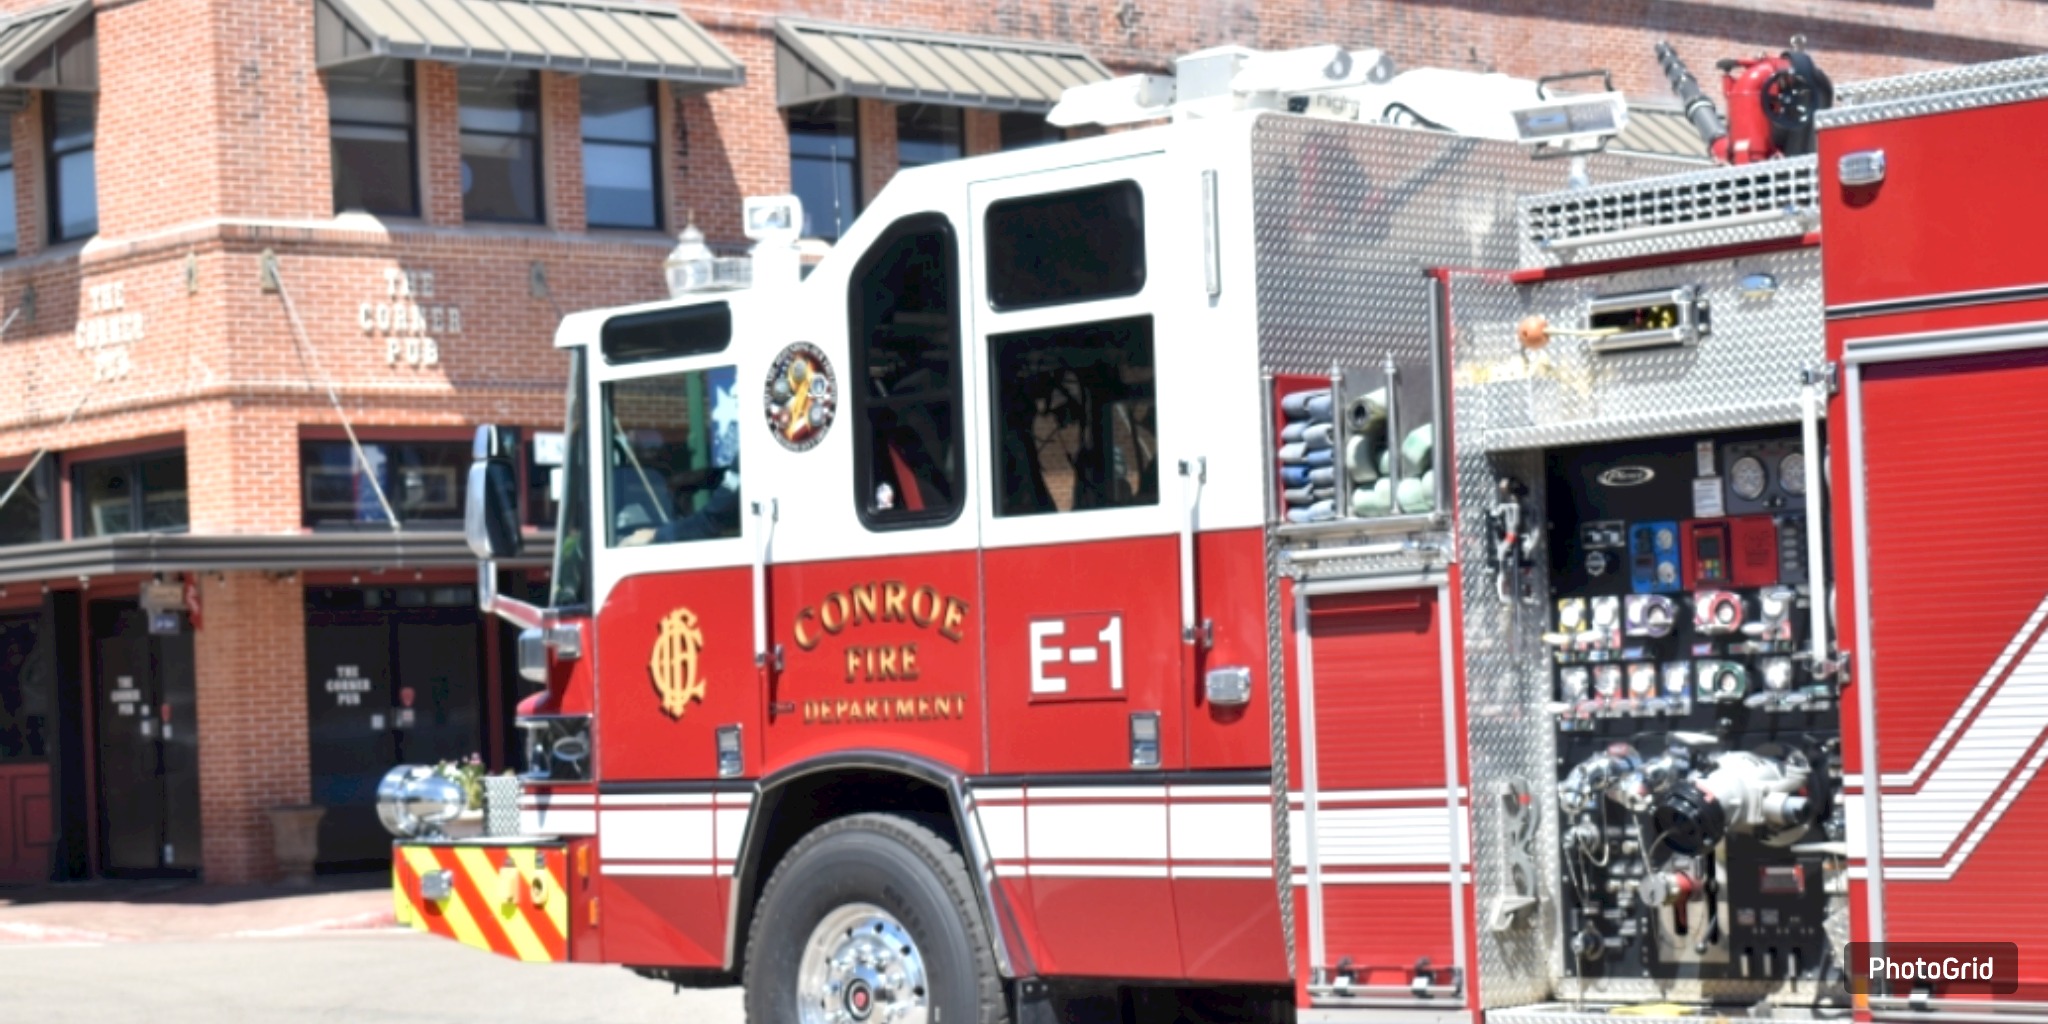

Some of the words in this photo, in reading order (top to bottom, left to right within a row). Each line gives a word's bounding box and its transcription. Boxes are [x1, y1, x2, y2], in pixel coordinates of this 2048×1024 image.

[89, 281, 124, 312] THE
[384, 267, 435, 296] THE
[76, 312, 145, 350] CORNER
[359, 302, 462, 333] CORNER
[386, 337, 439, 366] PUB
[794, 580, 968, 652] CONROE
[845, 644, 919, 683] FIRE
[1030, 616, 1123, 693] E-1
[336, 665, 359, 677] THE
[803, 694, 967, 725] DEPARTMENT
